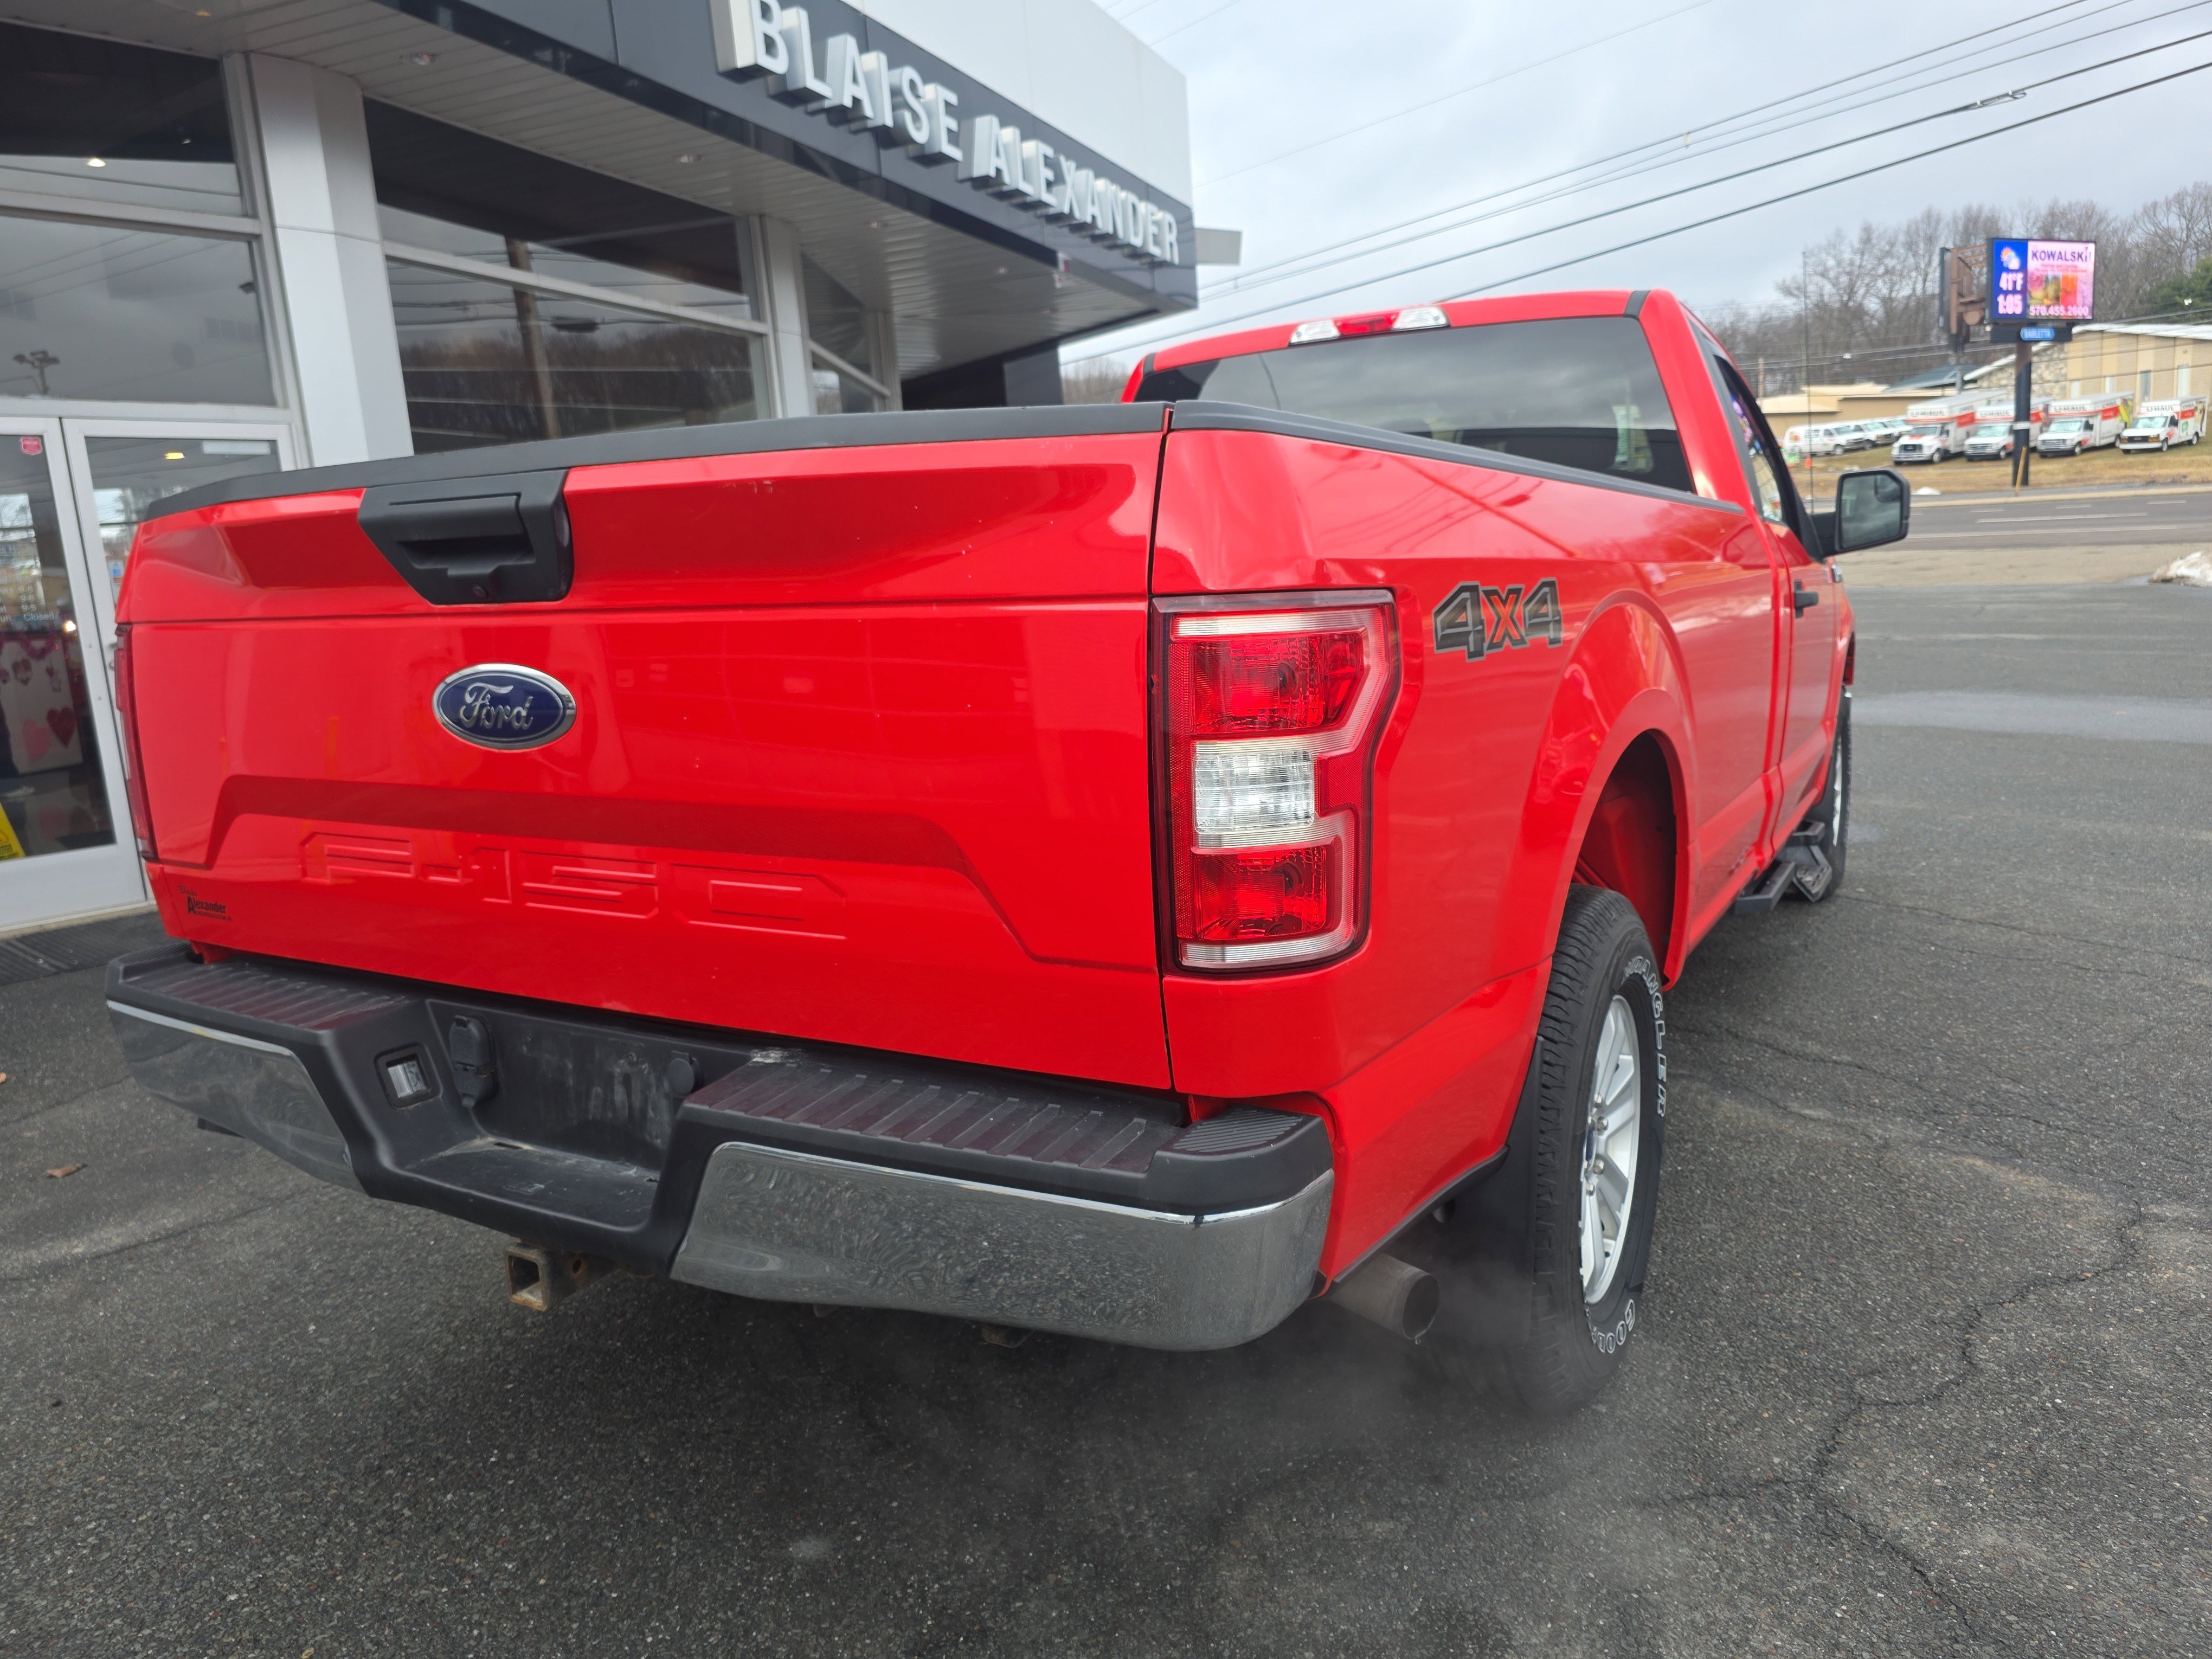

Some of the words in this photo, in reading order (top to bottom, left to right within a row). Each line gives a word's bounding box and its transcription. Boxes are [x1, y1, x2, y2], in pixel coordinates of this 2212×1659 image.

[743, 0, 963, 162] BLAISE
[974, 114, 1180, 266] ALEXANDER
[460, 681, 534, 729] Ford
[299, 832, 848, 941] F-150
